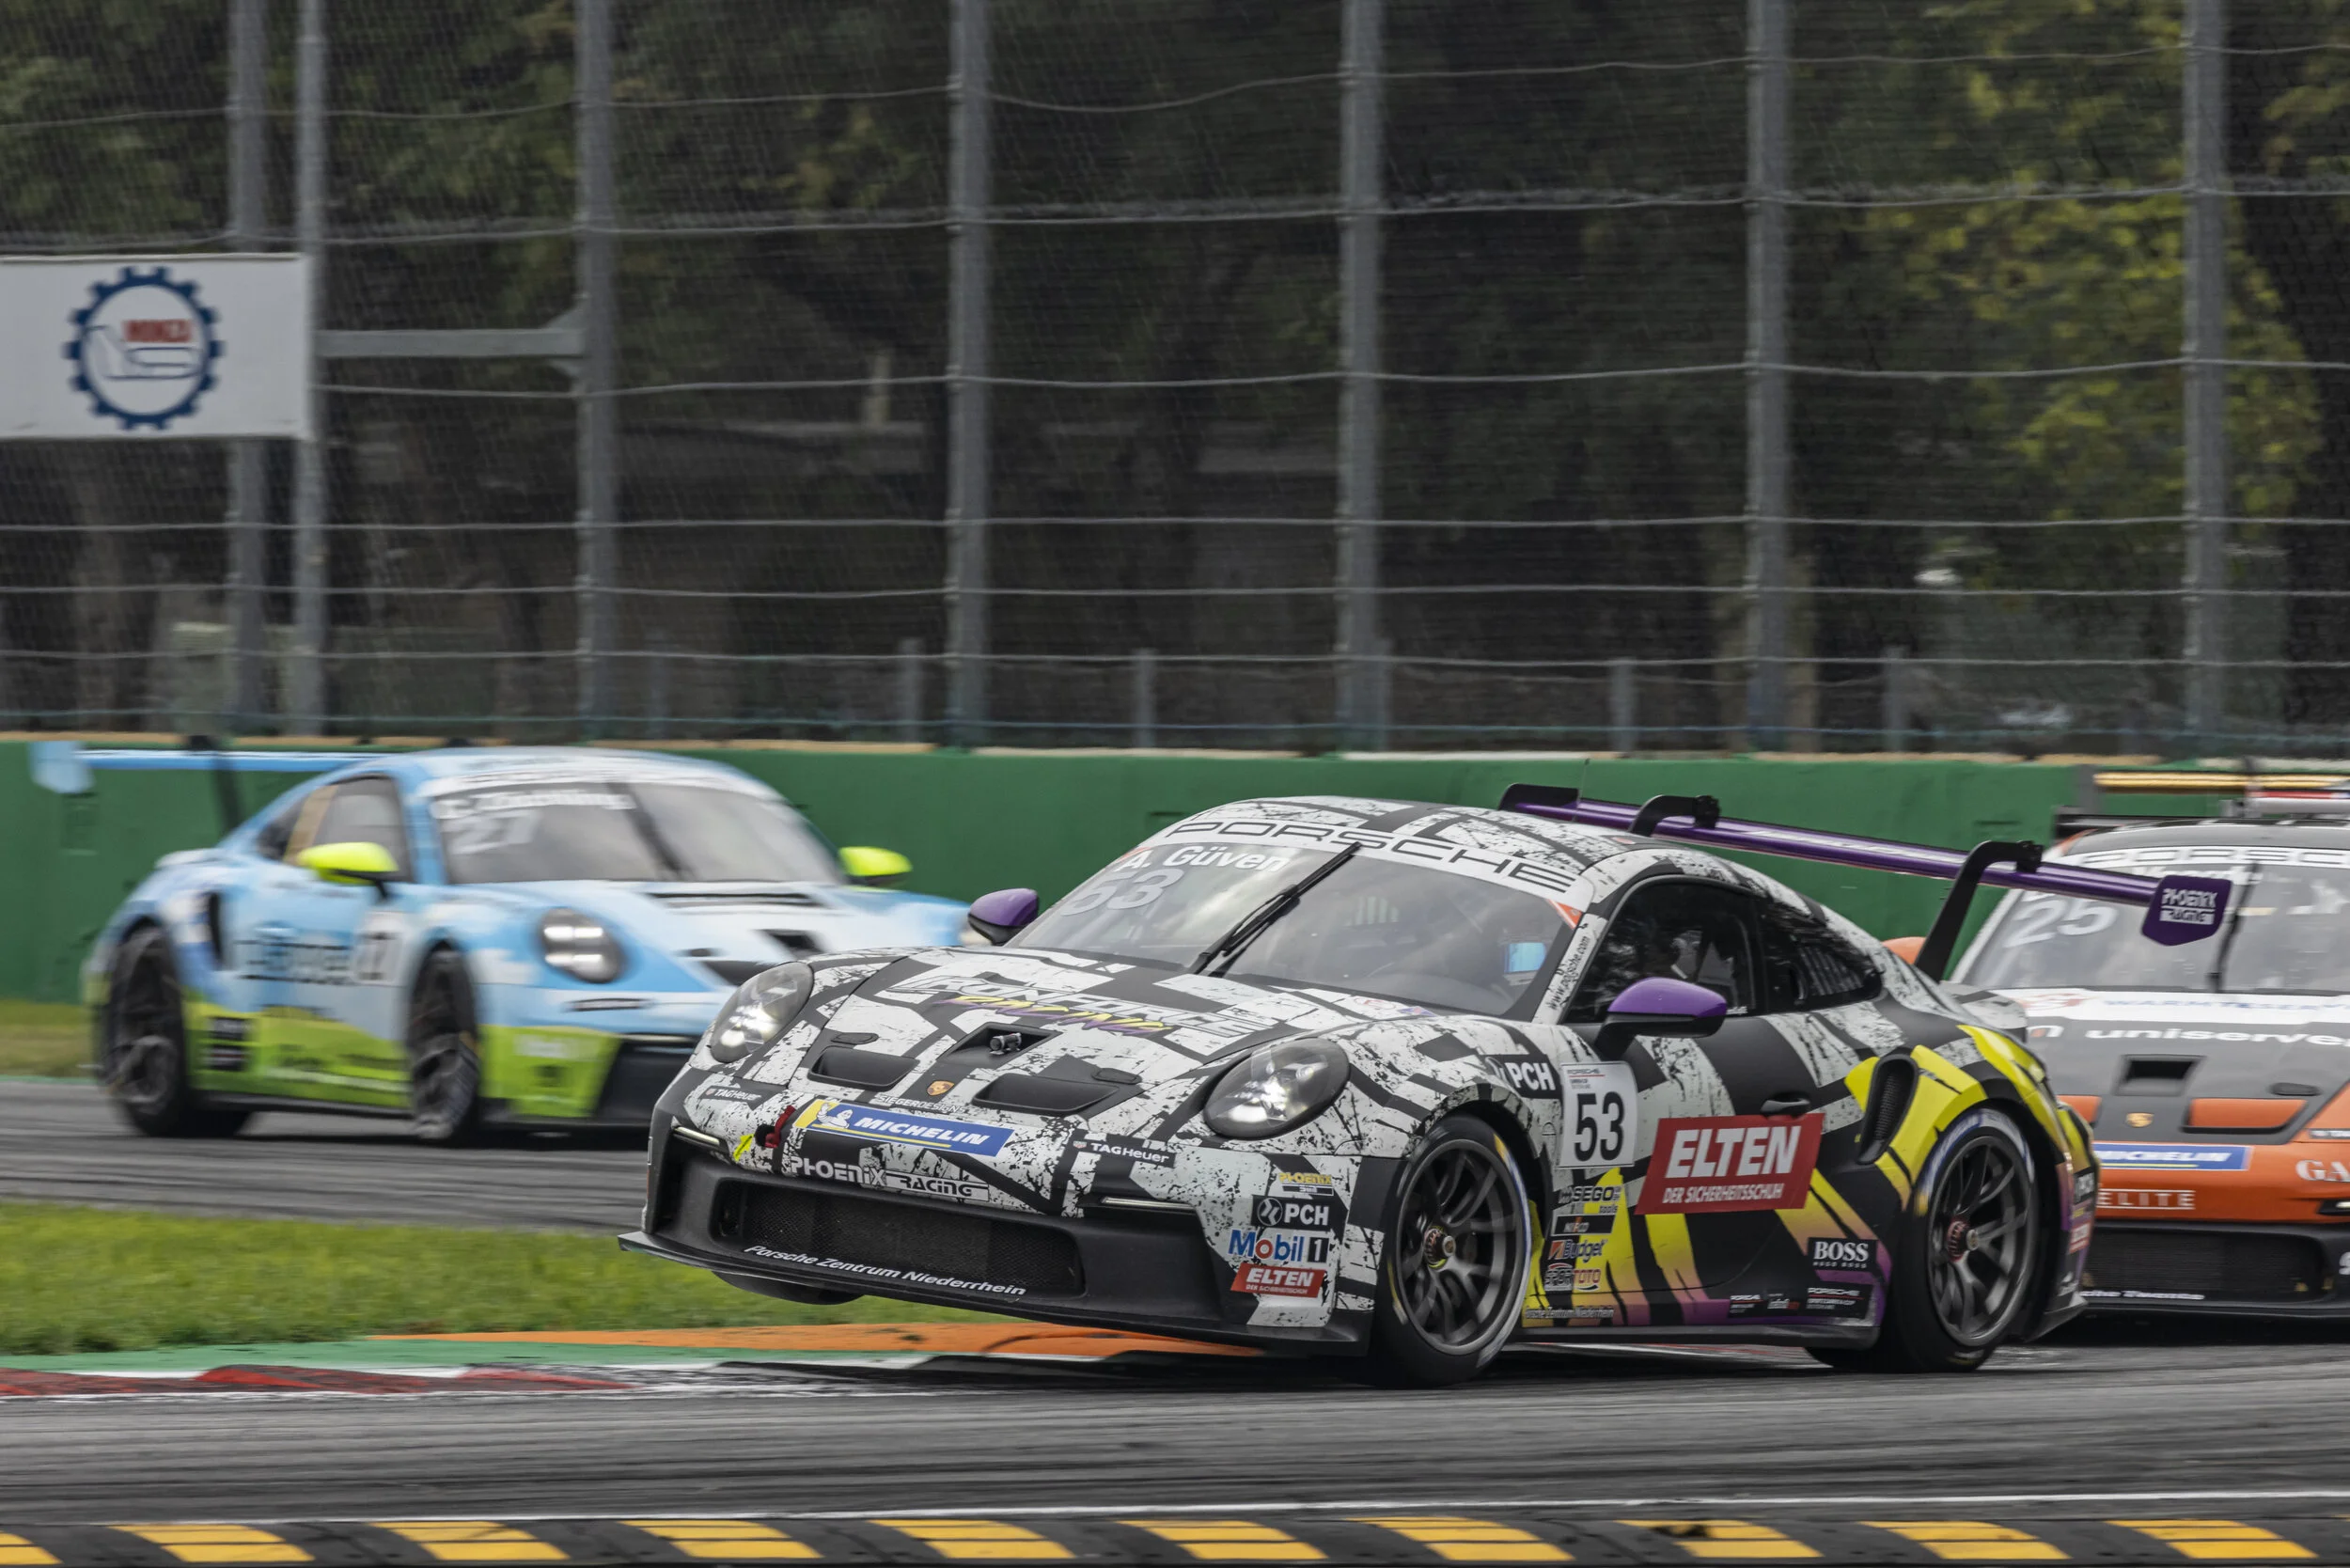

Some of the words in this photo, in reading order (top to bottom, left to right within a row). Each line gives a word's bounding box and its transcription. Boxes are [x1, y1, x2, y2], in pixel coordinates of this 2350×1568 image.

[1115, 849, 1153, 872] A.
[1163, 845, 1292, 872] Güven
[1166, 821, 1578, 894] PORSCHE
[2079, 849, 2350, 865] PORSC
[1060, 868, 1184, 917] 53
[2003, 898, 2118, 948] 25
[1505, 1062, 1557, 1090] PCH
[854, 1117, 991, 1146] MICHELIN
[1574, 1090, 1624, 1162] 53
[1664, 1126, 1802, 1179] ELTEN
[1573, 1185, 1615, 1202] SEGO
[1662, 1187, 1683, 1204] DER
[1283, 1203, 1330, 1226] PCH
[1228, 1229, 1305, 1262] Mobil
[1564, 1239, 1606, 1263] Budget
[1812, 1241, 1870, 1262] BOSS
[744, 1245, 818, 1265] Porsche
[816, 1257, 901, 1278] Zentrum
[901, 1270, 1027, 1296] Niederrhein
[1246, 1267, 1314, 1287] ELTEN
